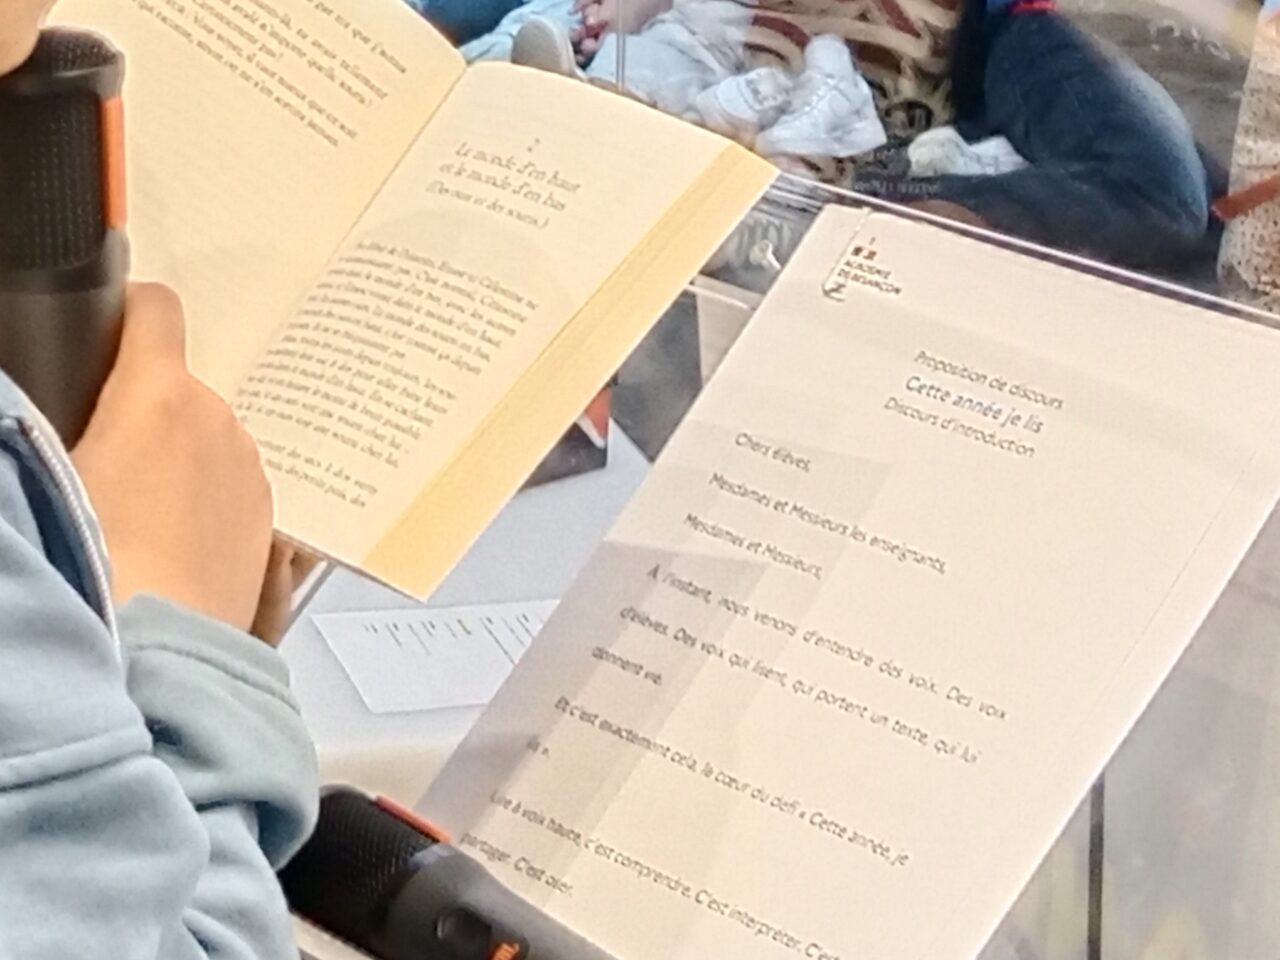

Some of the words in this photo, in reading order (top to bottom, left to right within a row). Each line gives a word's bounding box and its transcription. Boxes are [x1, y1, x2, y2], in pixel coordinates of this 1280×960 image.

[905, 375, 951, 402] Cette
[951, 394, 1002, 420] année
[999, 407, 1022, 428] je
[1022, 414, 1044, 434] lis
[913, 350, 987, 382] Proposition
[1008, 384, 1063, 409] discours
[734, 431, 771, 456] Chers
[883, 396, 939, 426] Discours
[940, 418, 1034, 456] d'introduction
[683, 512, 745, 547] Mesdames
[708, 472, 771, 507] Mesdames
[788, 503, 848, 535] Messieurs
[849, 524, 867, 542] les
[717, 597, 749, 616] nous
[753, 610, 797, 636] venons
[802, 630, 873, 667] d'entendre
[877, 659, 903, 679] des
[945, 685, 972, 707] Des
[978, 702, 1005, 719] voix
[672, 626, 696, 646] Des
[700, 641, 724, 659] voix
[727, 652, 749, 668] qui
[791, 679, 814, 695] qui
[813, 689, 868, 718] portent
[933, 738, 960, 754] qui
[959, 745, 982, 763] lui
[554, 695, 570, 713] Et
[749, 787, 769, 803] du
[808, 811, 847, 838] Cette
[513, 855, 545, 881] C'est
[583, 838, 615, 860] c'est
[693, 888, 729, 915] C'est
